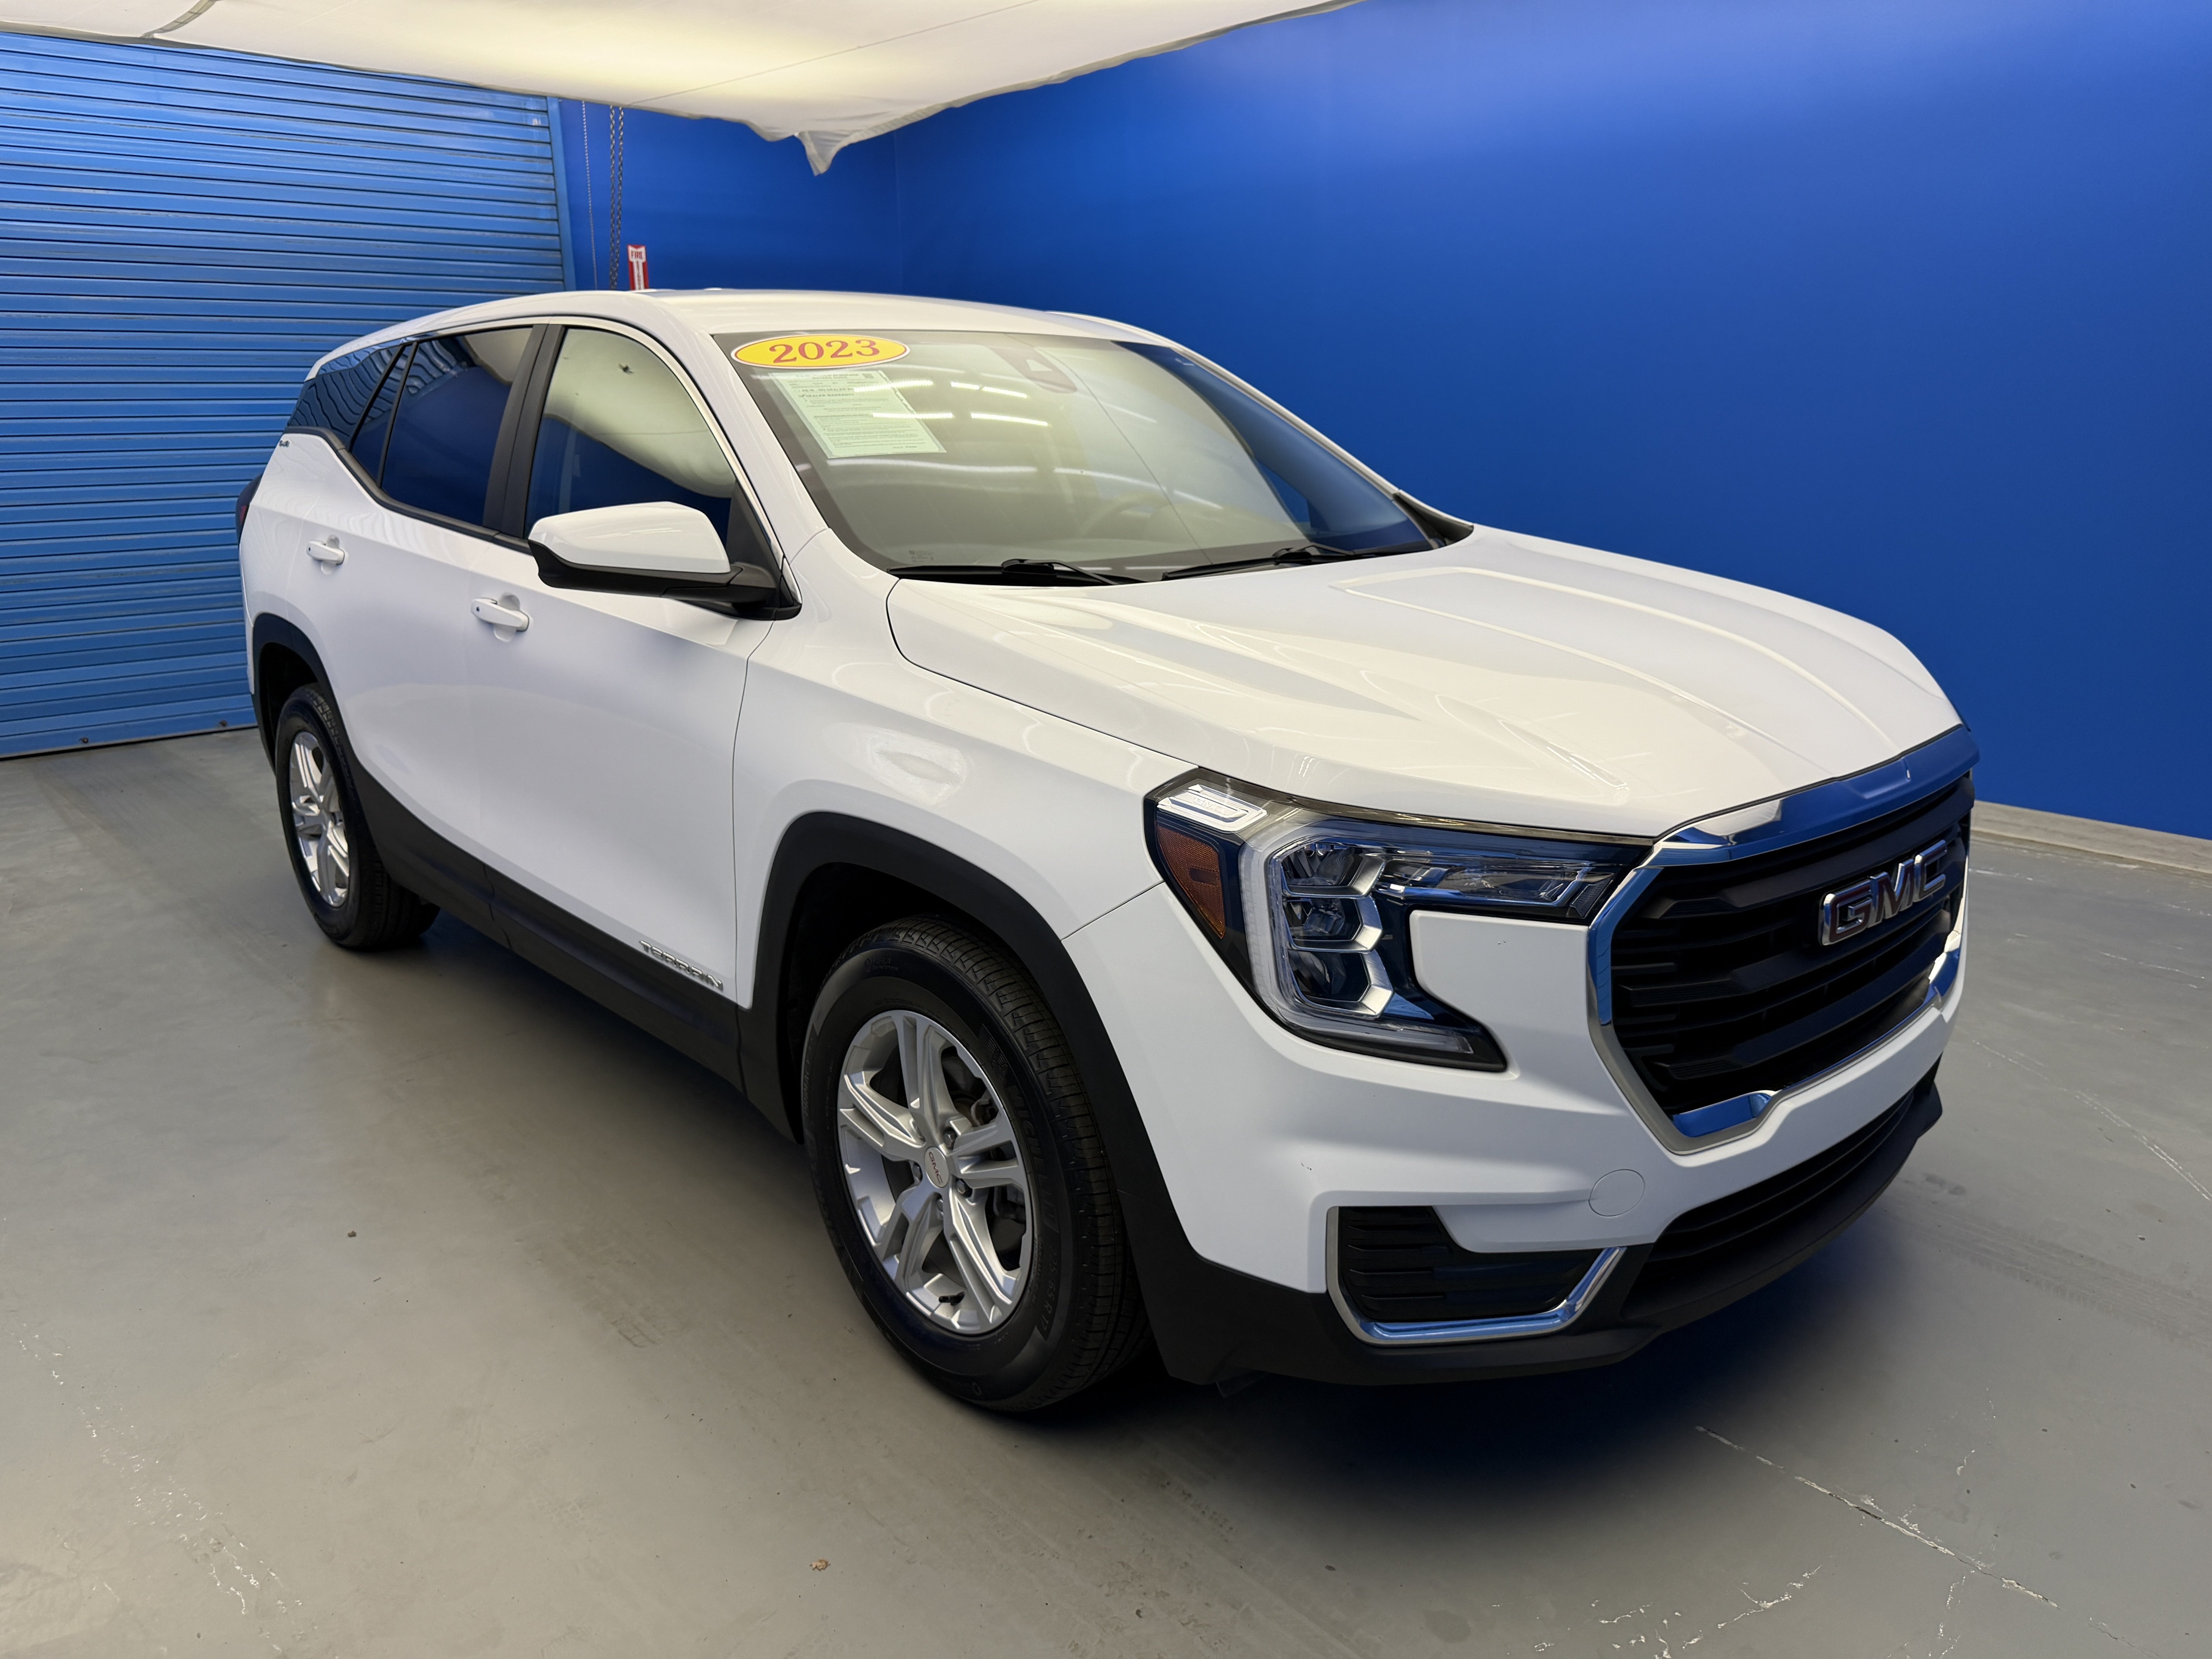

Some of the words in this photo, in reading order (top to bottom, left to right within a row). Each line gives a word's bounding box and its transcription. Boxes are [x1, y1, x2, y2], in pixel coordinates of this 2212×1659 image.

[769, 339, 880, 363] 2023
[1821, 839, 1947, 946] GMC
[639, 940, 723, 992] TERRAIN
[929, 1151, 943, 1184] GMC
